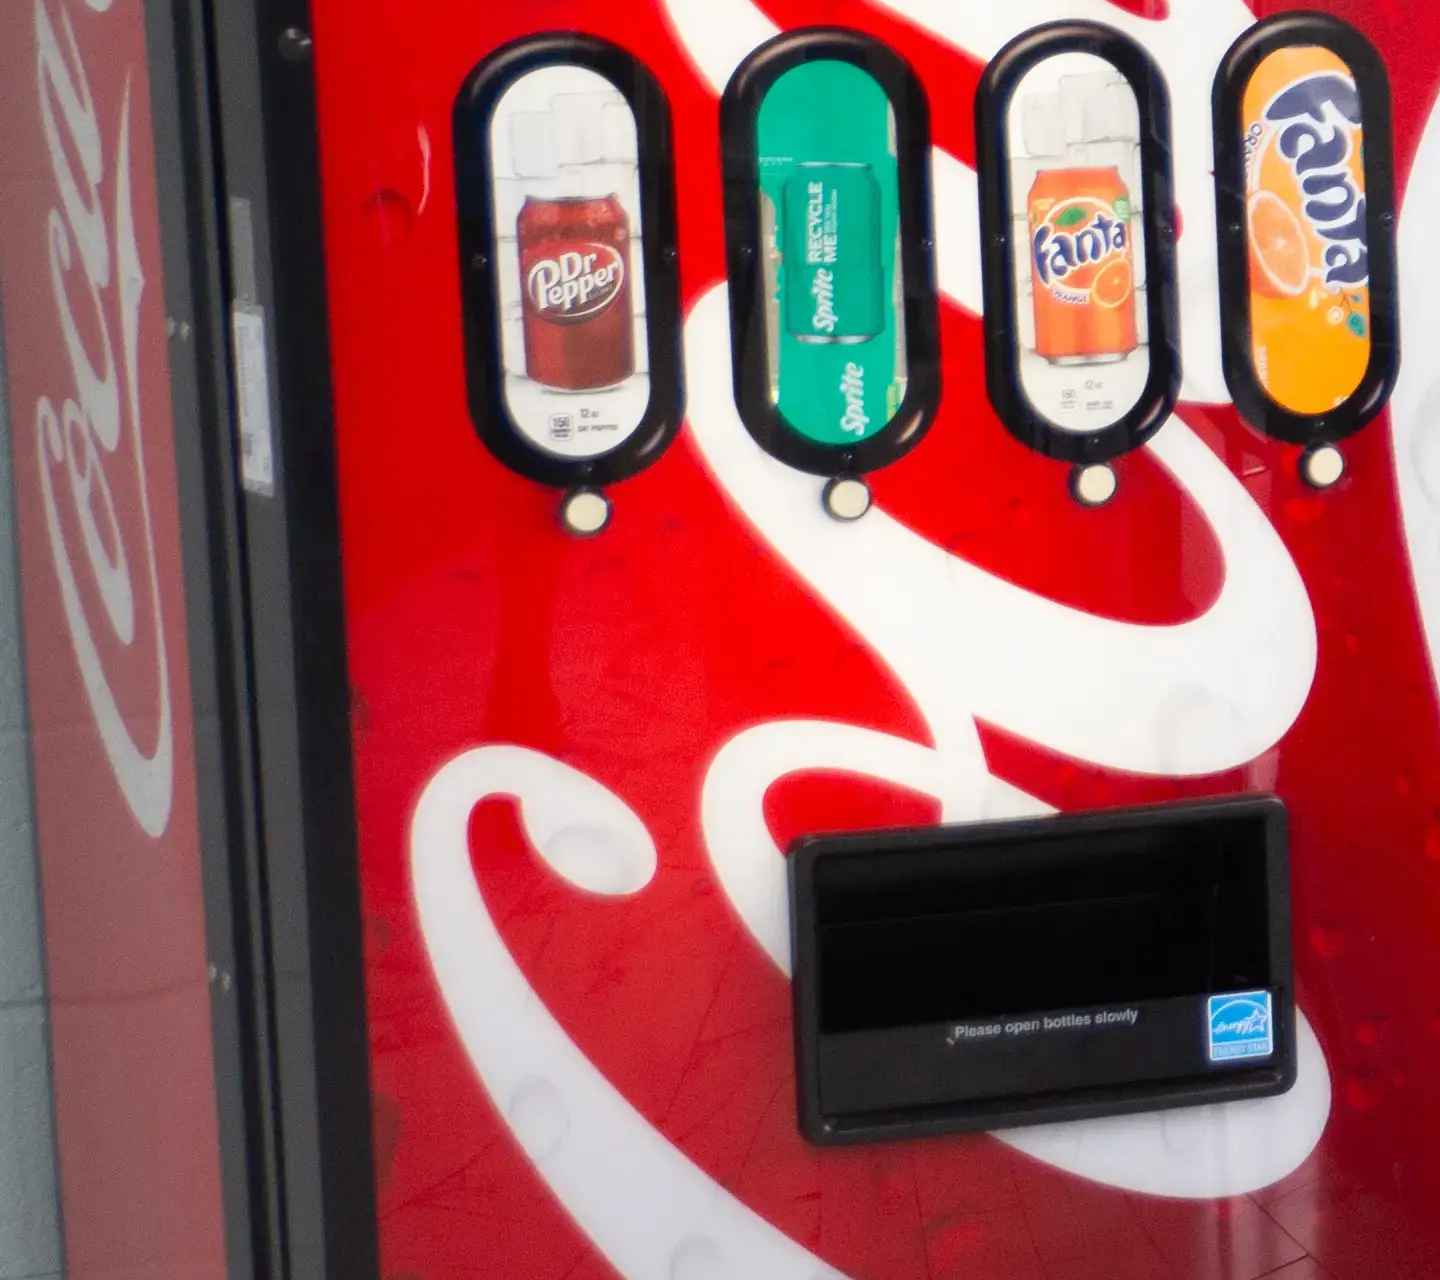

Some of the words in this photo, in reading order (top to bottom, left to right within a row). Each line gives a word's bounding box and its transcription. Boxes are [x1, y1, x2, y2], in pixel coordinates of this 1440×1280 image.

[1265, 70, 1369, 287] Fanta
[807, 182, 823, 263] RECYCLE
[823, 234, 837, 263] ME
[1033, 213, 1128, 286] Fanta
[535, 260, 619, 311] Pepper
[560, 252, 597, 281] Dr
[811, 268, 838, 333] Sprite
[840, 362, 870, 435] Sprite
[955, 1025, 1002, 1039] Please
[1004, 1021, 1040, 1036] open
[1043, 1013, 1092, 1029] bottles
[1095, 1009, 1139, 1025] slowly
